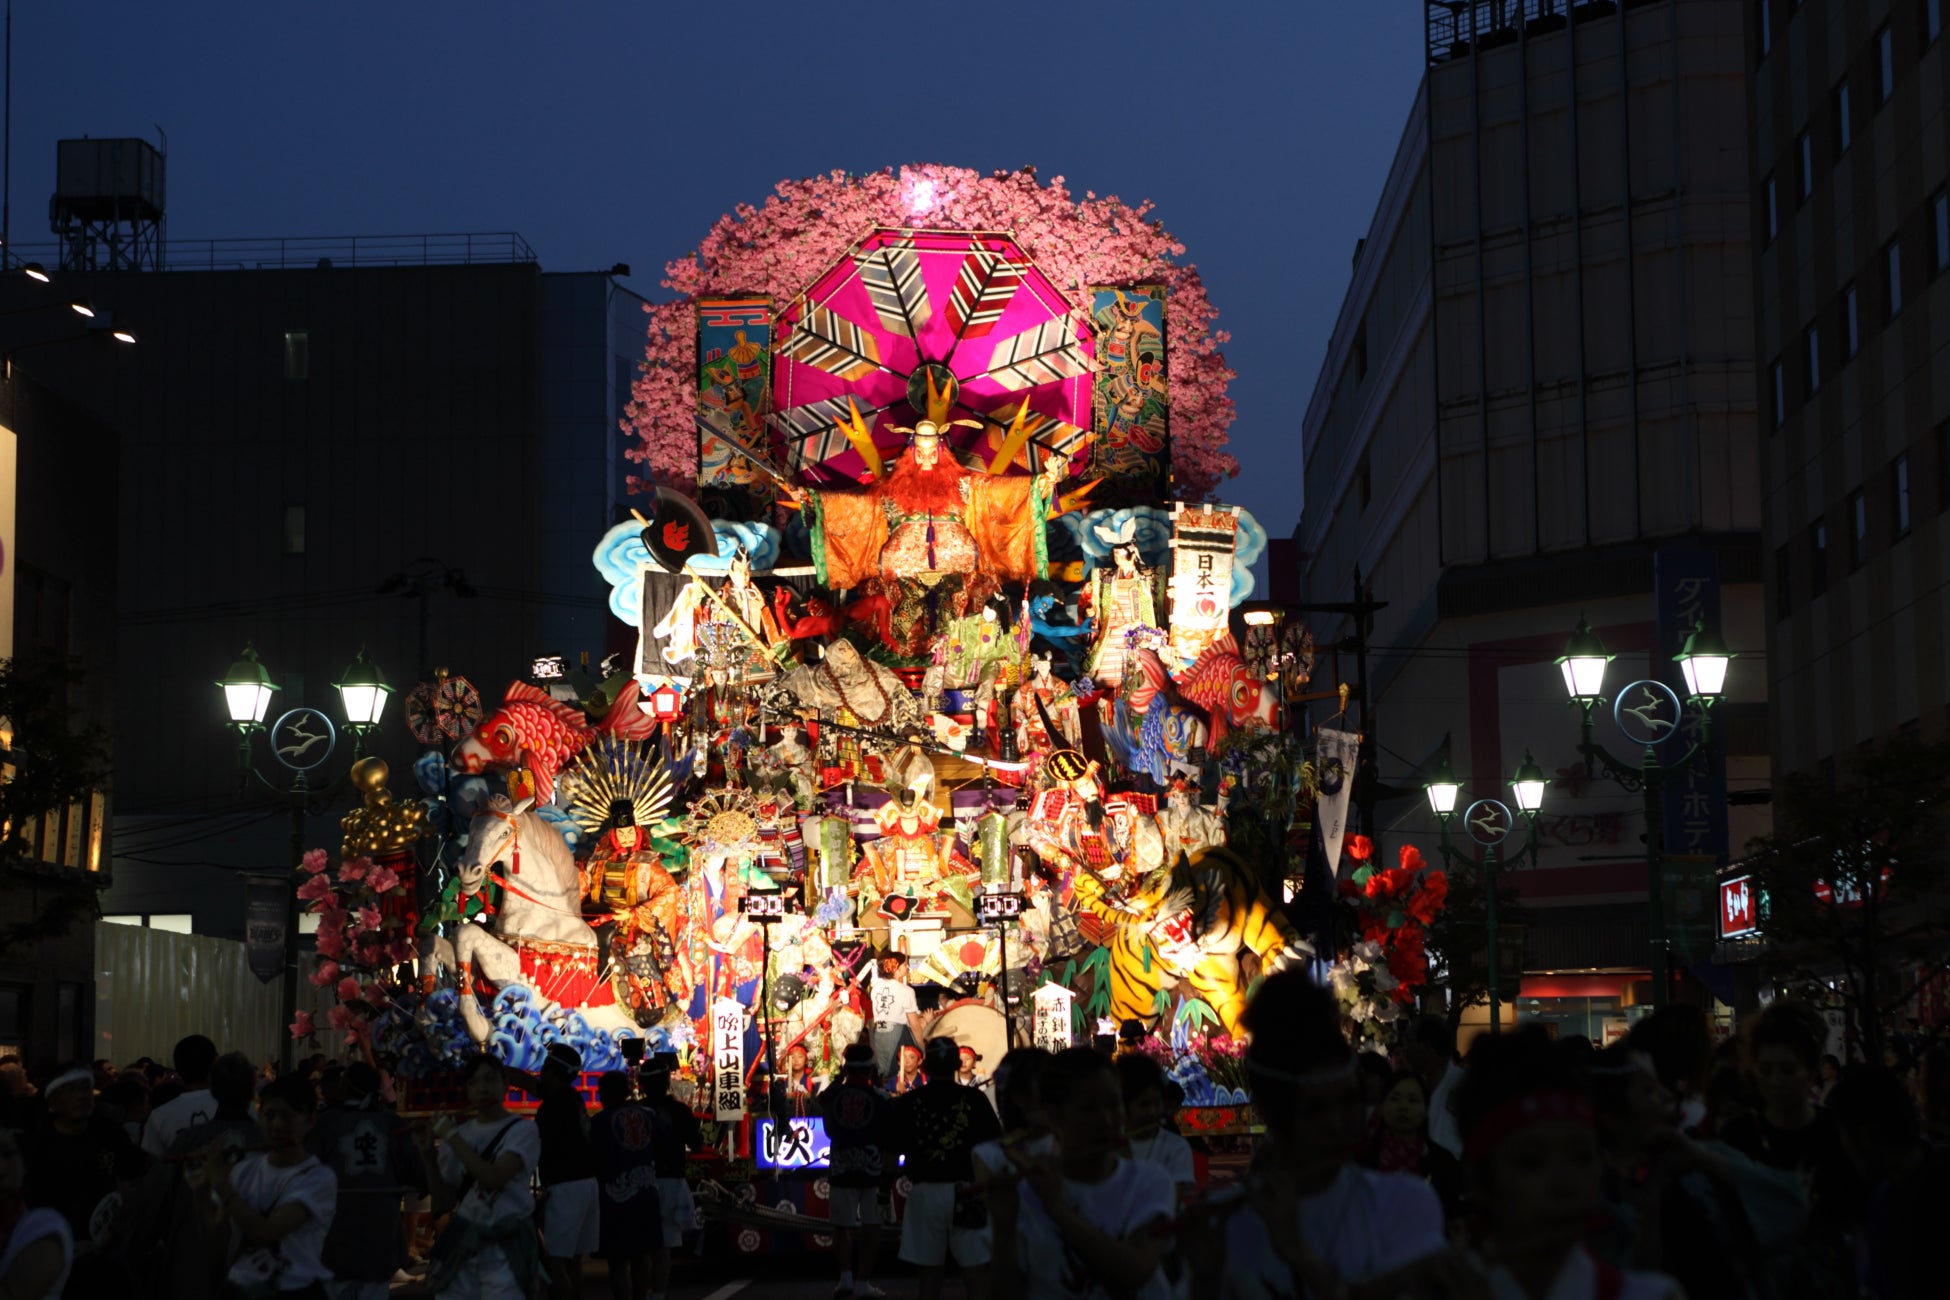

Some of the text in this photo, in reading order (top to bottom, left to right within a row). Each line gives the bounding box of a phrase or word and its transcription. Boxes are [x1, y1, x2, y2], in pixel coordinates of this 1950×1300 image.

[1196, 554, 1215, 597] 日本一
[717, 1013, 742, 1111] 吹上山車組
